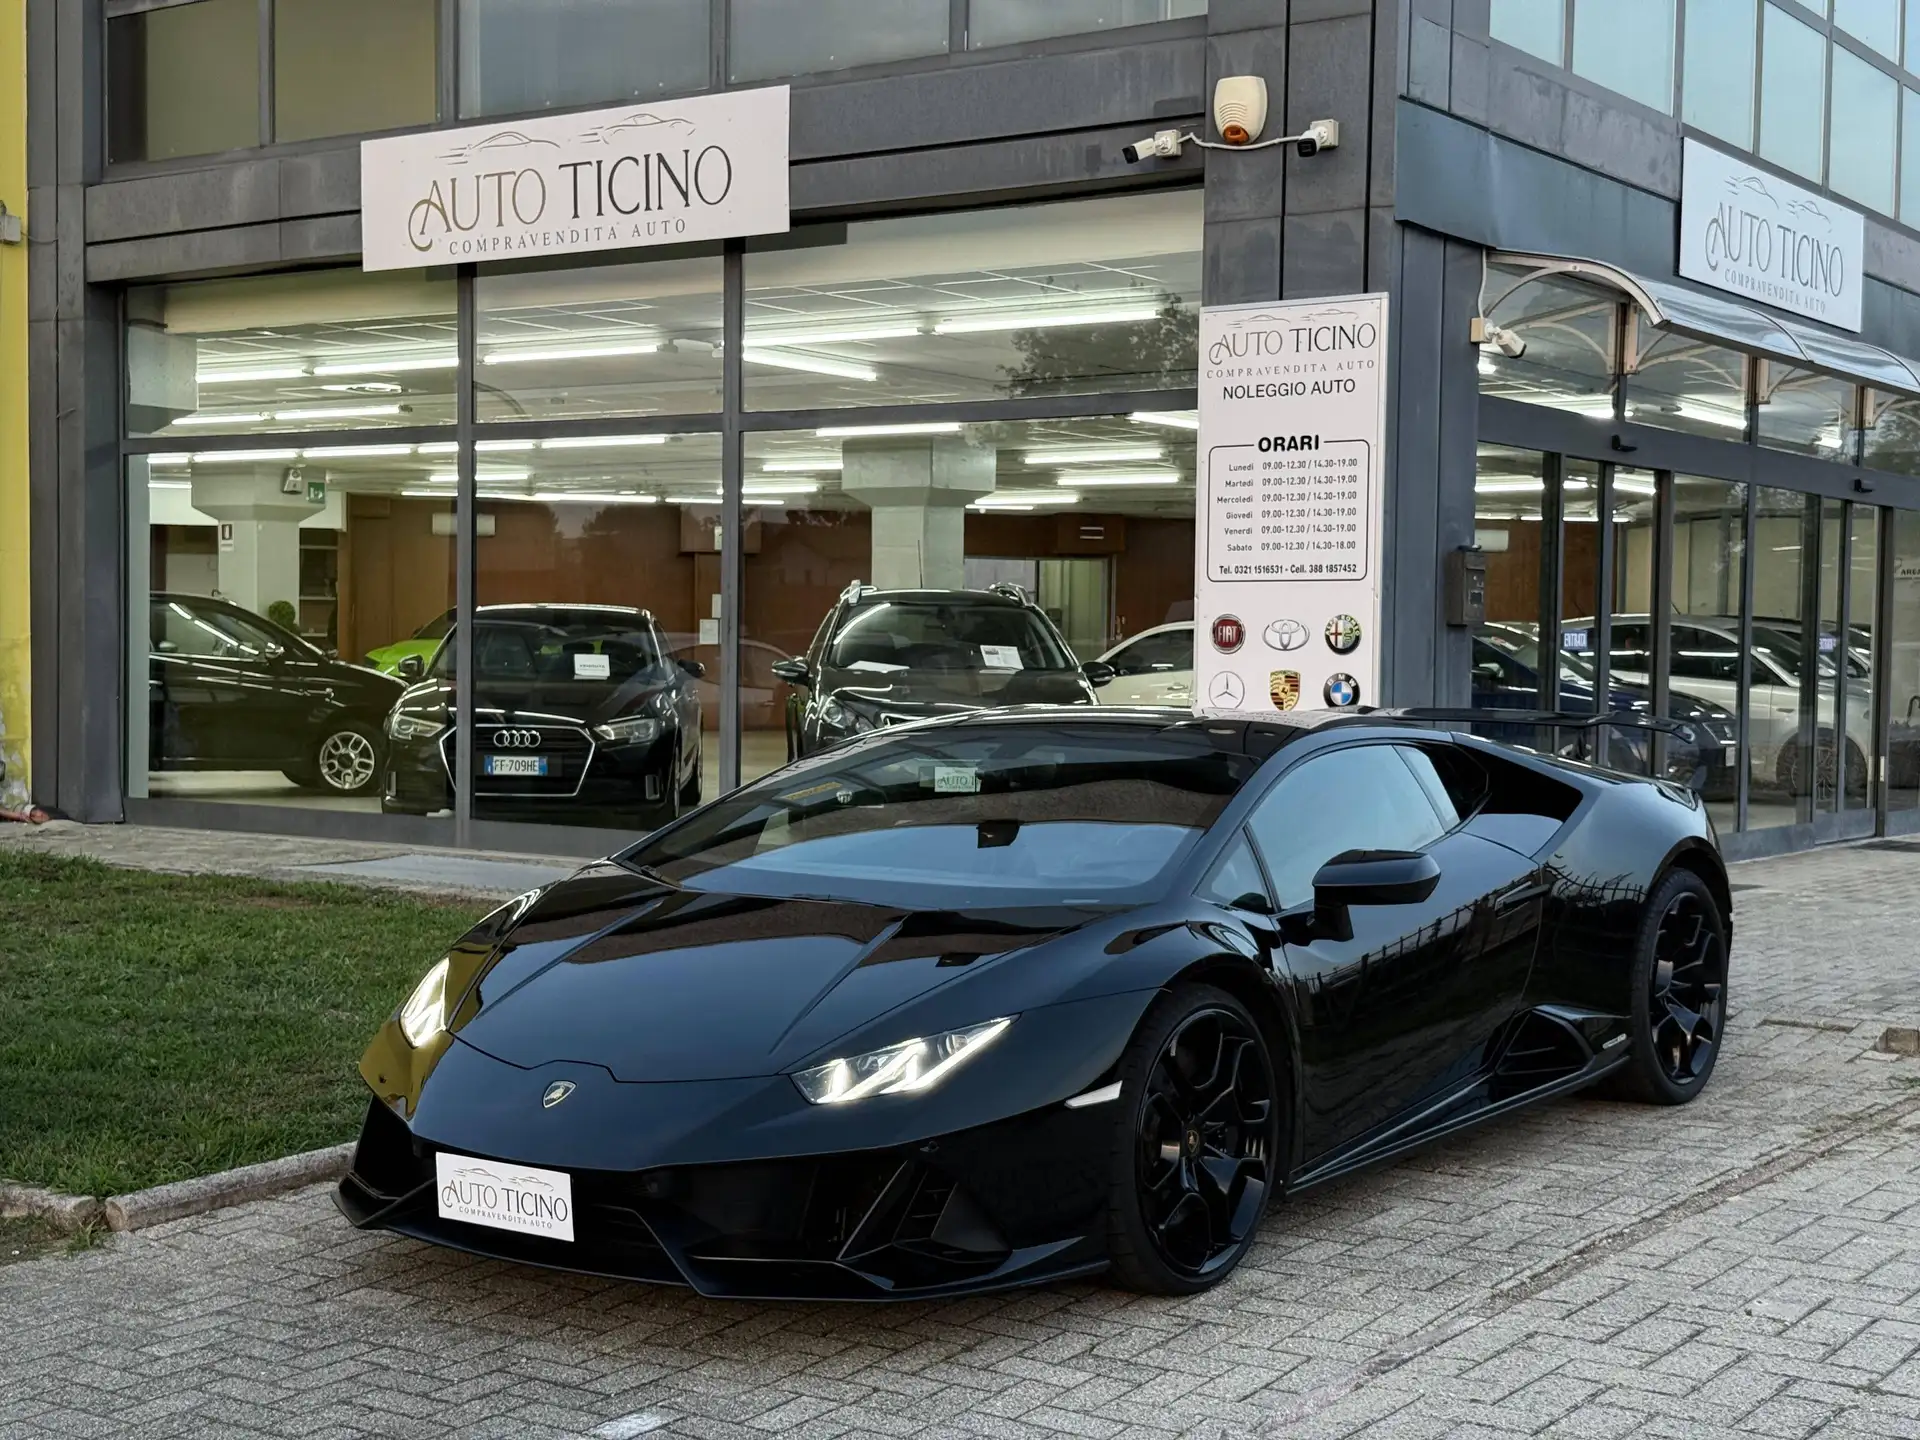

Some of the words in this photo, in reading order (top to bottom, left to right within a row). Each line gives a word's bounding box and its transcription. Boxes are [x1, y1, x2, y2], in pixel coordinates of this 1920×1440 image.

[408, 168, 546, 252] AUTO
[558, 145, 732, 219] TICINO
[450, 226, 618, 255] COMPRAVENDITA
[632, 218, 686, 238] AUTO
[1705, 201, 1771, 272] AUTO
[1777, 225, 1843, 297] TICINO
[1724, 268, 1801, 305] COMPRAVENDITA
[1804, 298, 1826, 315] AUTO
[1208, 330, 1283, 365] AUTO
[1289, 322, 1376, 353] TICINO
[1206, 363, 1327, 379] COMPRAVENDITA
[1336, 359, 1375, 371] AUTO
[1223, 381, 1306, 400] NOLEGGIO
[1310, 378, 1356, 395] AUTO
[1258, 434, 1319, 452] ORARI
[1262, 461, 1306, 470] 09.00-12.30
[1313, 459, 1357, 468] 14.30-19.00
[1261, 477, 1306, 486] 09.00-12.30
[1313, 475, 1357, 484] 14.30-19.00
[1261, 493, 1305, 502] 09.00-12.30
[1312, 491, 1357, 500] 14.30-19.00
[1261, 509, 1305, 518] 09.00-12.30
[1312, 507, 1356, 516] 14.30-19.00
[1260, 526, 1305, 535] 09.00-12.30
[1312, 524, 1356, 533] 14.30-19.00
[1227, 543, 1253, 552] Sabato
[1260, 542, 1304, 551] 09.00-12.30
[1311, 541, 1356, 550] 14.30-18.00
[1219, 566, 1231, 575] Tel.
[1234, 565, 1251, 574] 0321
[1290, 564, 1306, 574] Cell.
[1309, 564, 1323, 573] 388
[1218, 625, 1238, 643] FIAT
[1327, 673, 1357, 687] BMW
[441, 1178, 497, 1209] AUTO
[501, 1187, 568, 1222] TICINO
[459, 1206, 527, 1225] COMPRAVENDITA
[529, 1219, 553, 1229] AUTO
